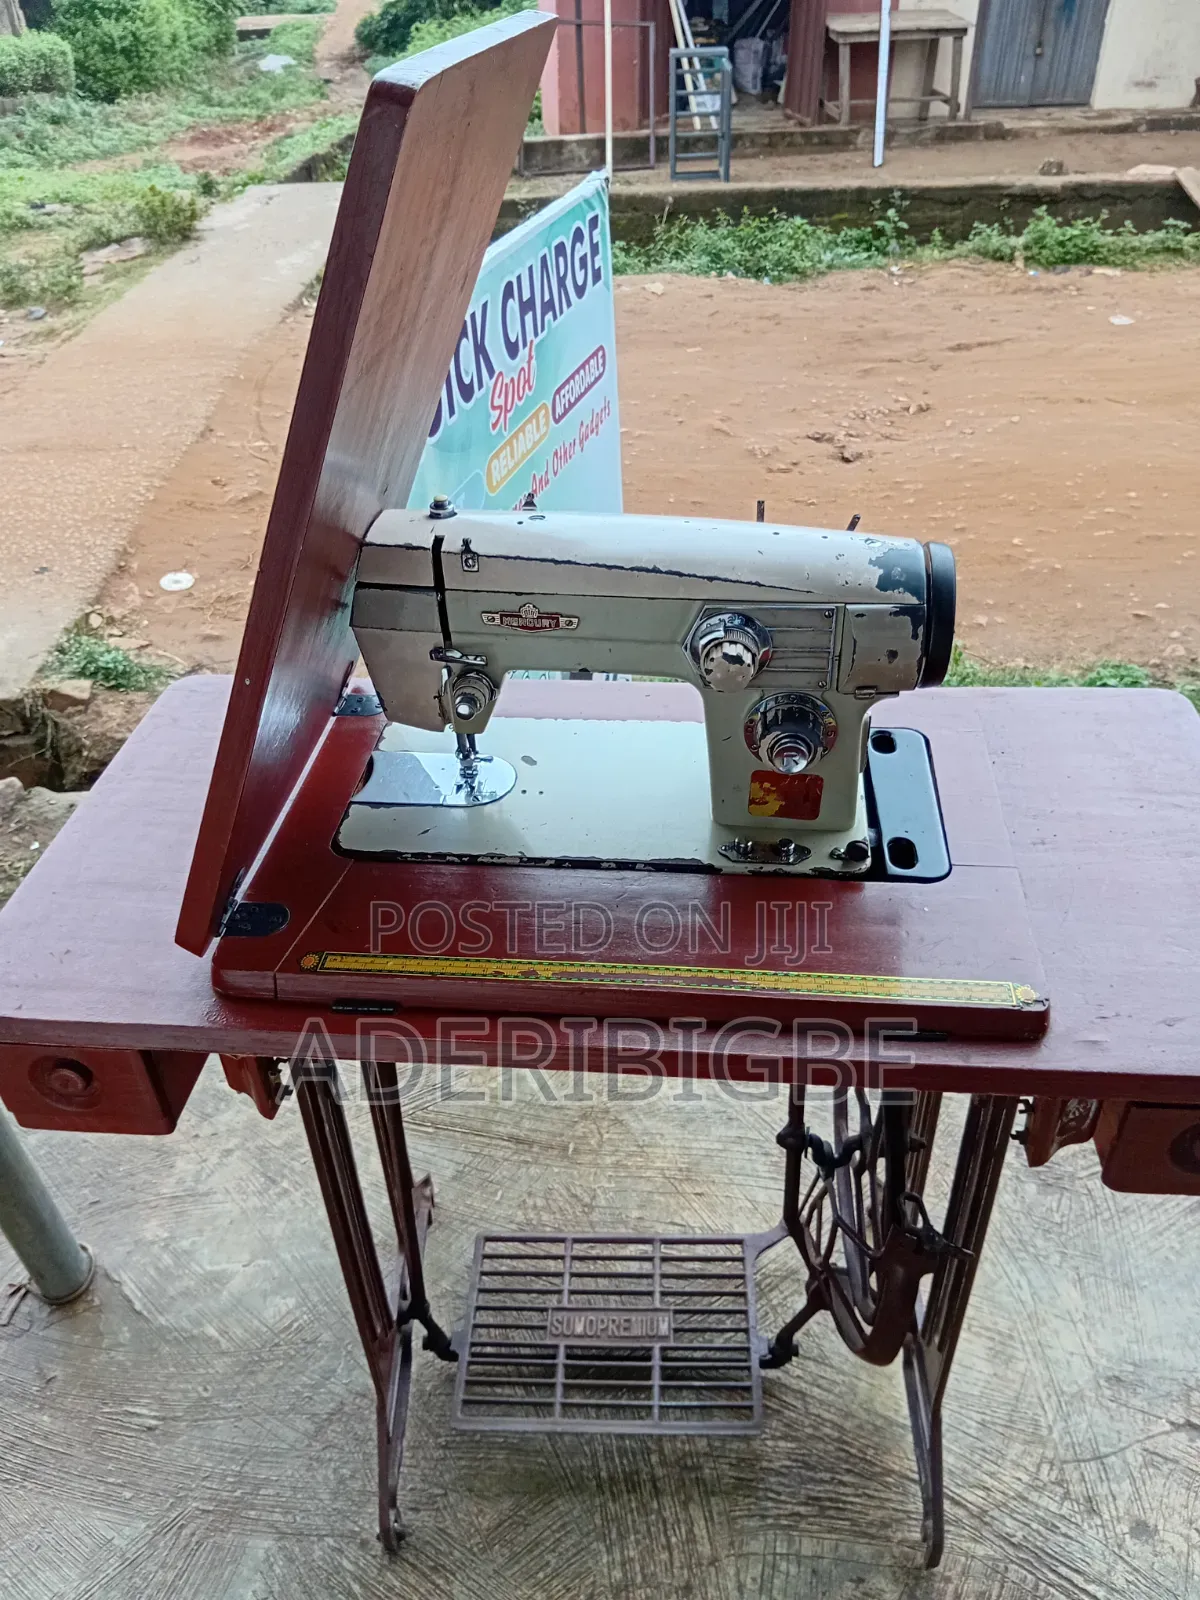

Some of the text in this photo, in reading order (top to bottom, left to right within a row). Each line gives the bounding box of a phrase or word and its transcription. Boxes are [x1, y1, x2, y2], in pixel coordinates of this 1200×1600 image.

[501, 214, 602, 361] CHARGE
[490, 340, 534, 432] Spot
[491, 350, 604, 487] RELIABLE AFFORDABLE
[531, 396, 610, 497] And Other Gadgets
[502, 616, 557, 628] MERCURY
[783, 752, 800, 767] R
[552, 1314, 669, 1338] SUMOPREMIUM
